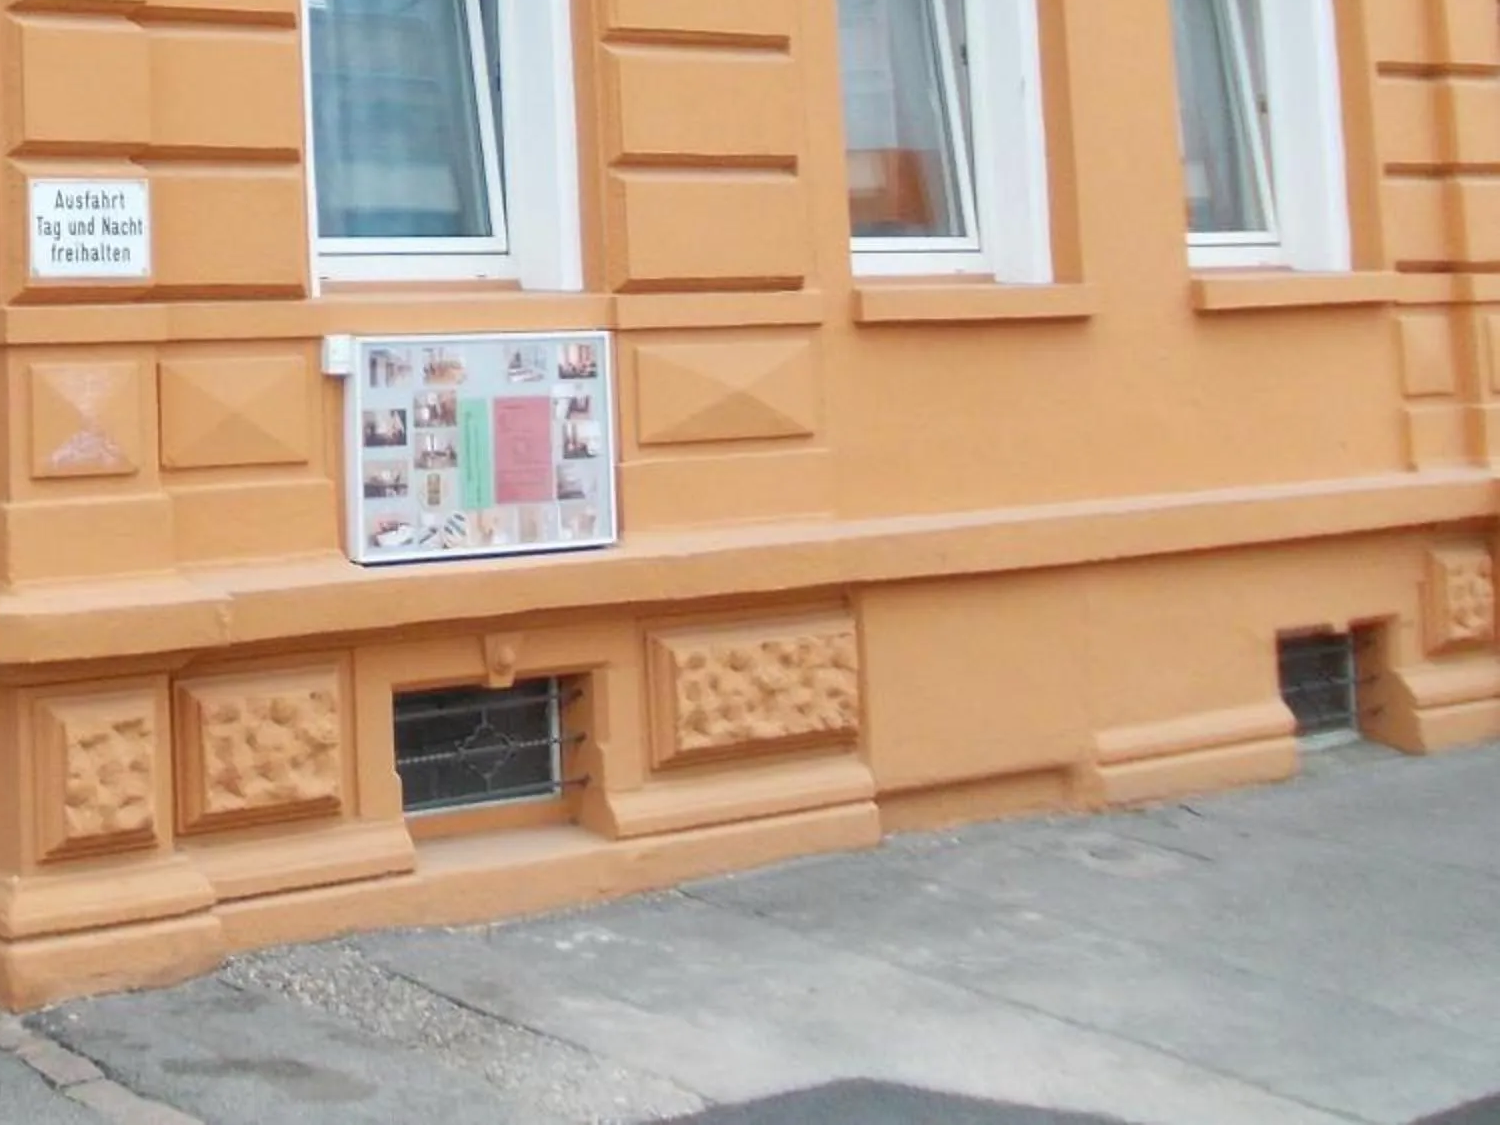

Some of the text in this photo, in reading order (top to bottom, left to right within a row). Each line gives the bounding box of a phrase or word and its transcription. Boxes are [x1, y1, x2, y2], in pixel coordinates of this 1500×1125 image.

[54, 189, 125, 210] Ausfahrt
[36, 216, 143, 241] Tag und Nacht
[51, 243, 131, 262] freihalten
